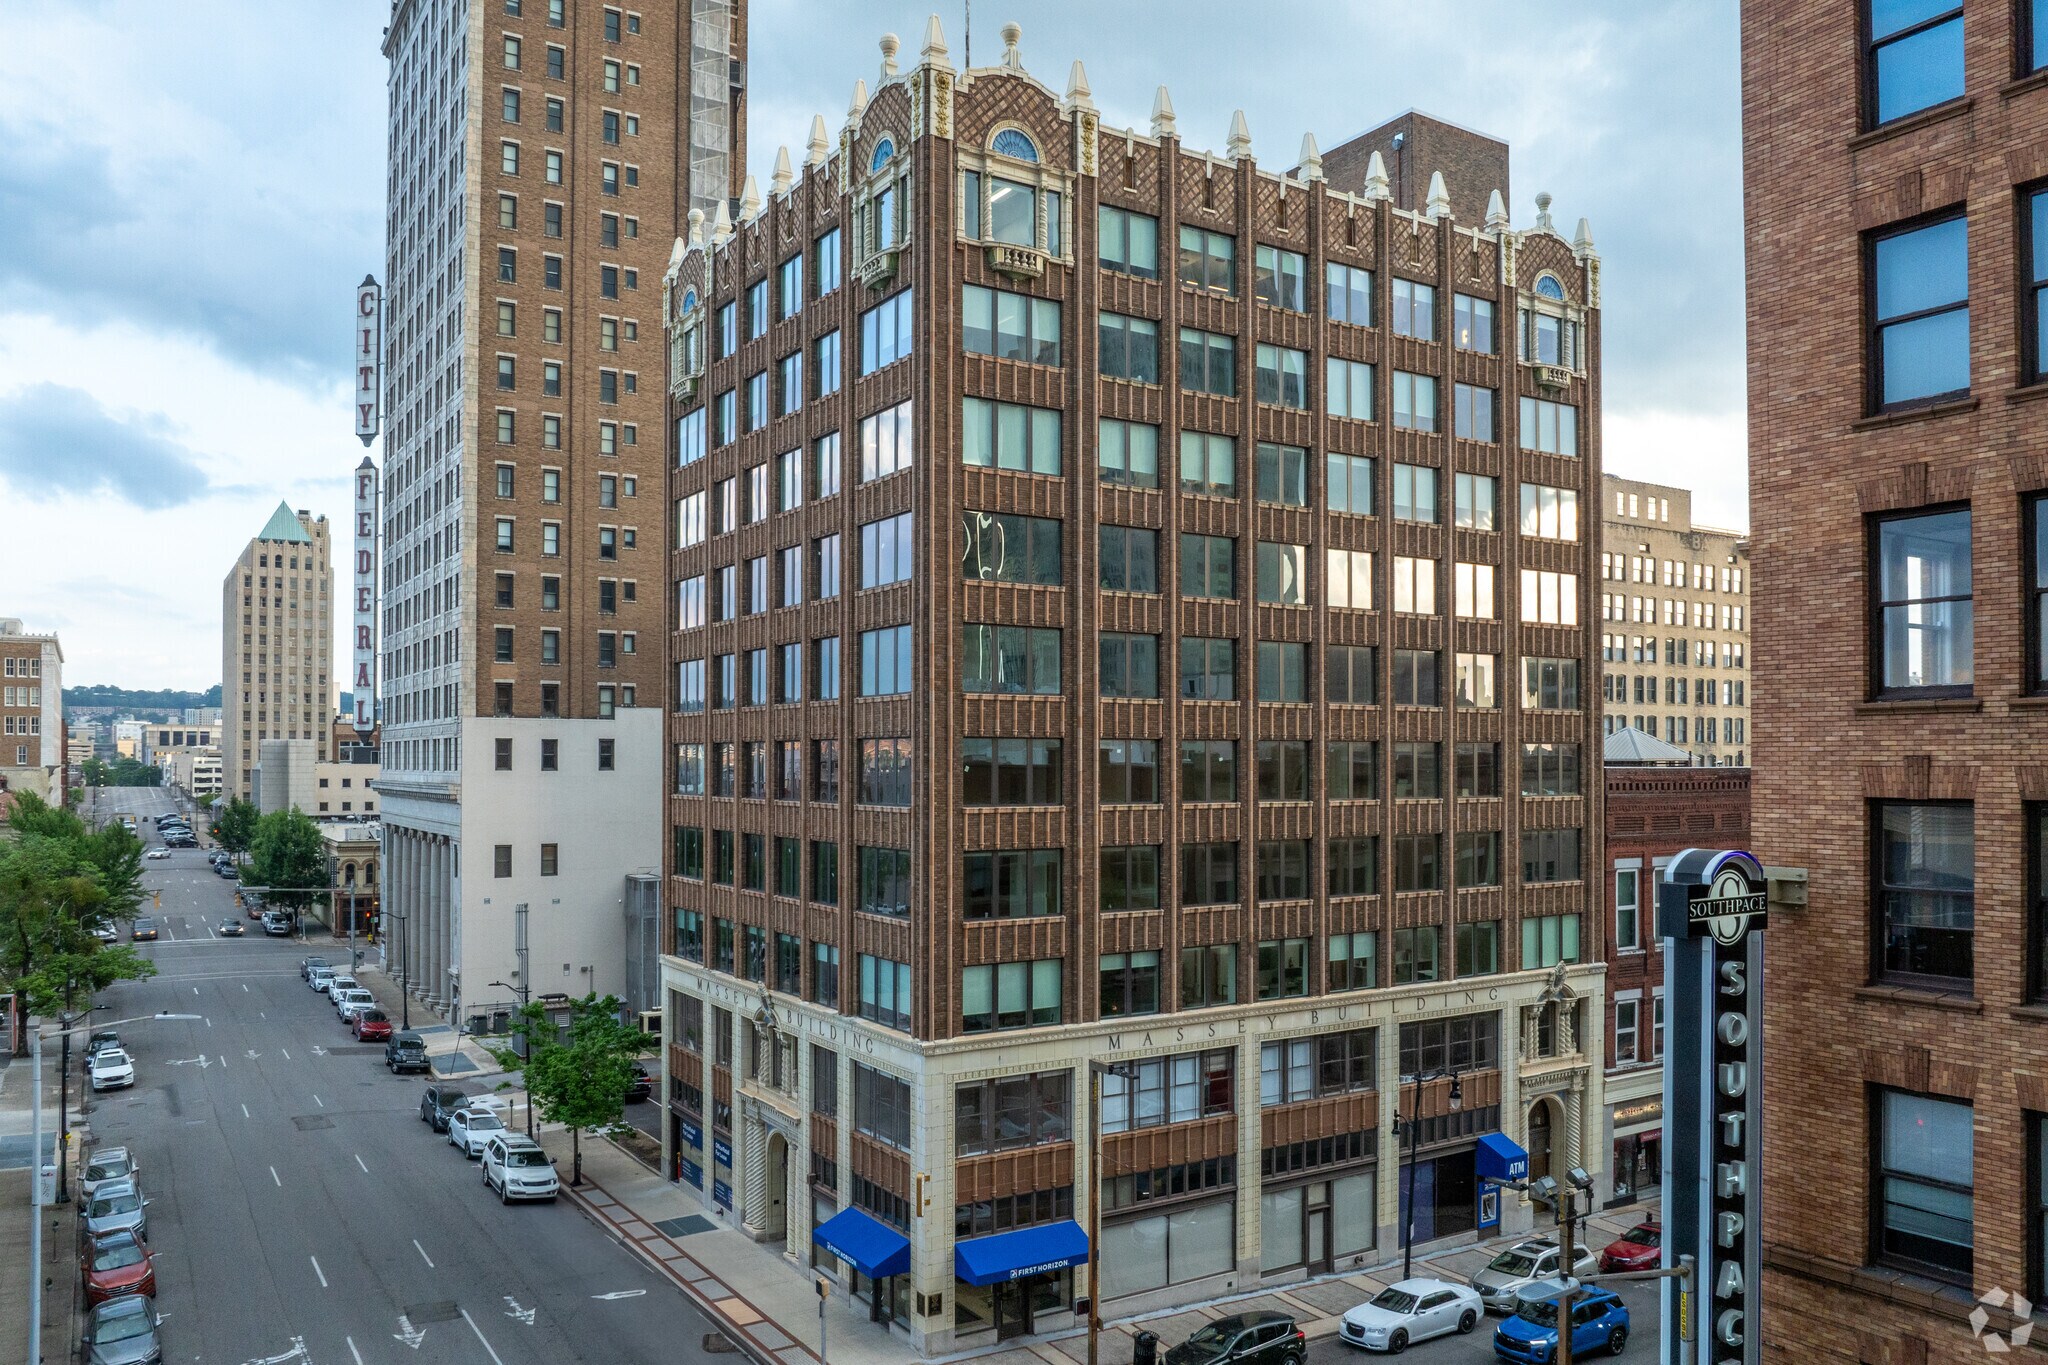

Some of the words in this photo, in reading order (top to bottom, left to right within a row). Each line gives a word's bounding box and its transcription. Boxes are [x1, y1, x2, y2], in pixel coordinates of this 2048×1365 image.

[358, 292, 374, 428] CITY
[357, 475, 372, 725] FEDERAL
[1690, 897, 1766, 918] SOUTHPACE
[697, 978, 749, 1008] MASSEY
[787, 1010, 873, 1054] BUILDING
[1108, 1016, 1277, 1050] MASSEY
[1311, 988, 1498, 1024] BUILDING
[1509, 1161, 1525, 1175] ATM
[1716, 960, 1748, 1365] SOUTHPAC
[831, 1245, 840, 1255] FIRST
[841, 1252, 857, 1267] HORIZON
[1018, 1266, 1037, 1276] FIRST
[1038, 1260, 1068, 1271] HORIZON
